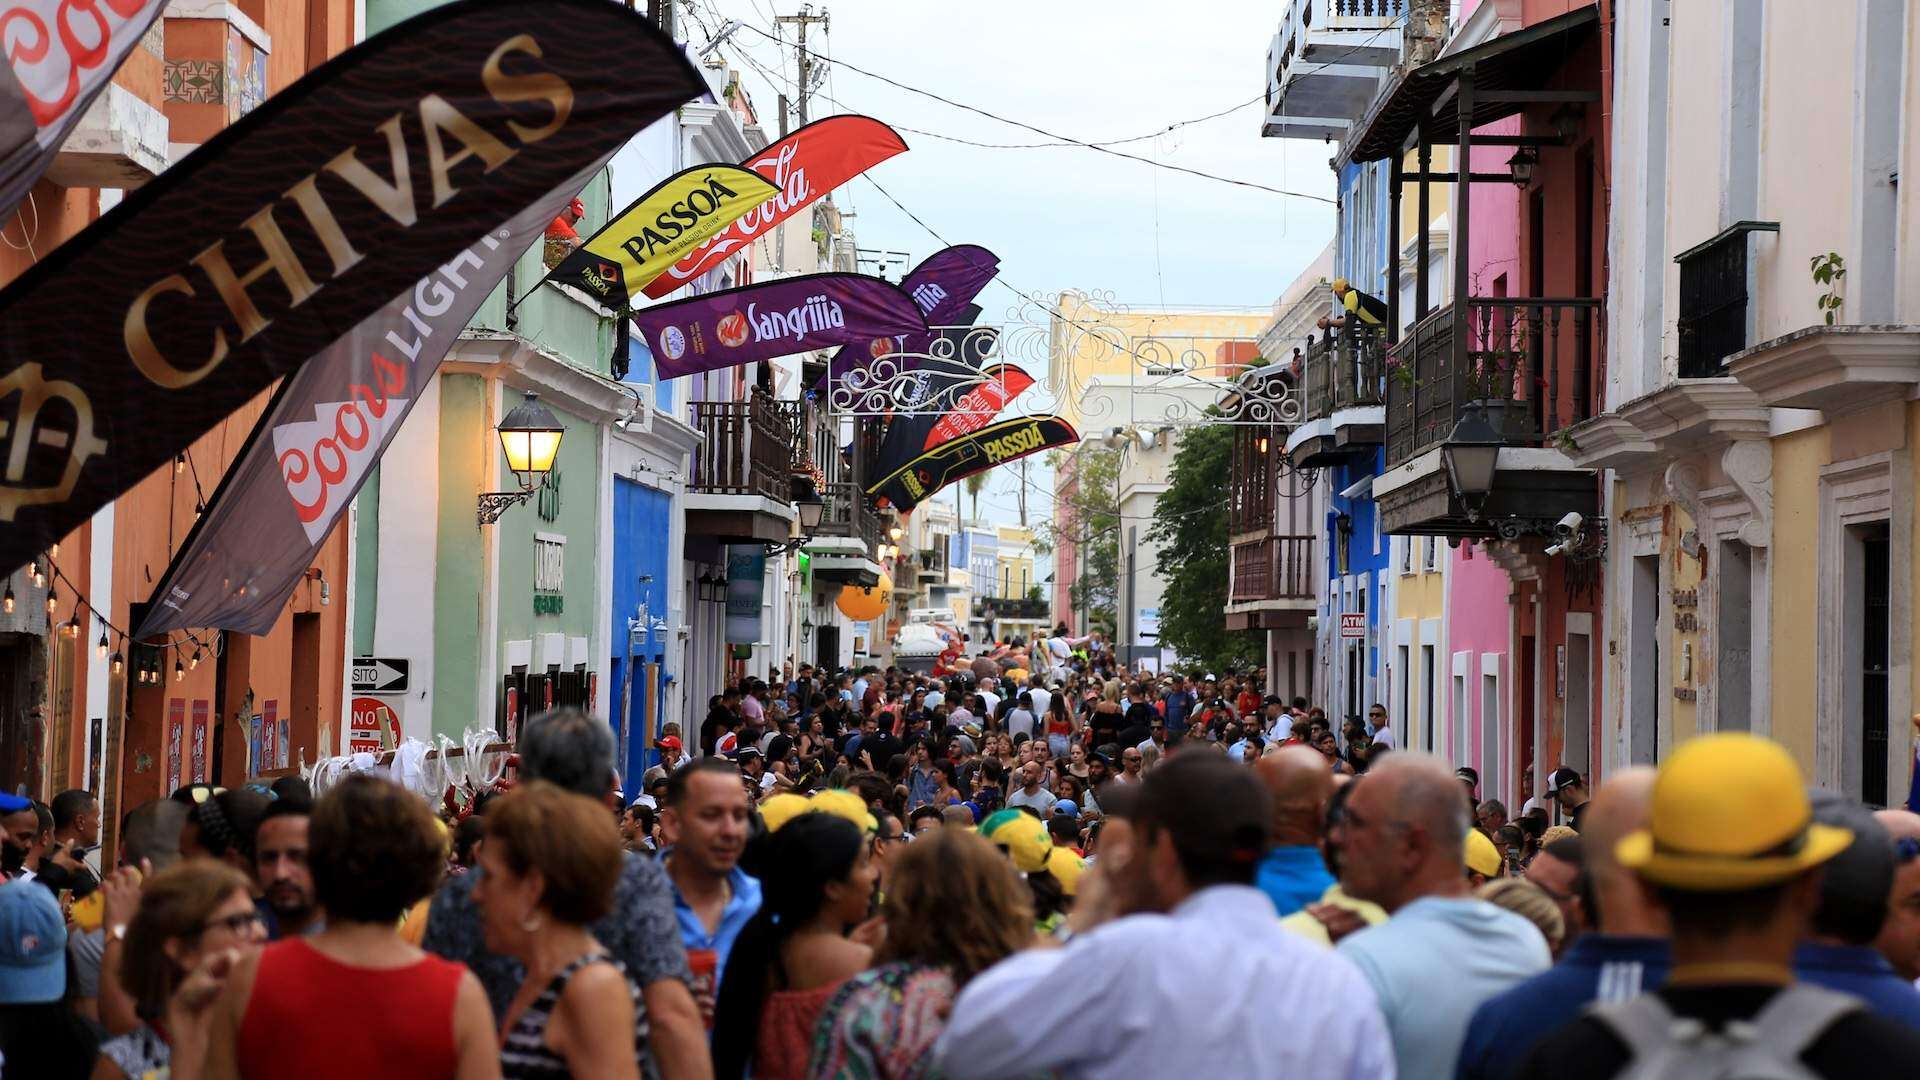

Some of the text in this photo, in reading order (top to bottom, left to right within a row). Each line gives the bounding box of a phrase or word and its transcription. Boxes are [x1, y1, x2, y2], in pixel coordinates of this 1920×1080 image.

[123, 34, 575, 390] CHIVAS
[621, 173, 739, 265] PASSOÃ
[748, 294, 846, 343] Sangriiia
[279, 351, 407, 523] Coors
[983, 421, 1046, 464] PASSOÃ
[1342, 617, 1364, 627] ATM
[353, 711, 376, 725] NO
